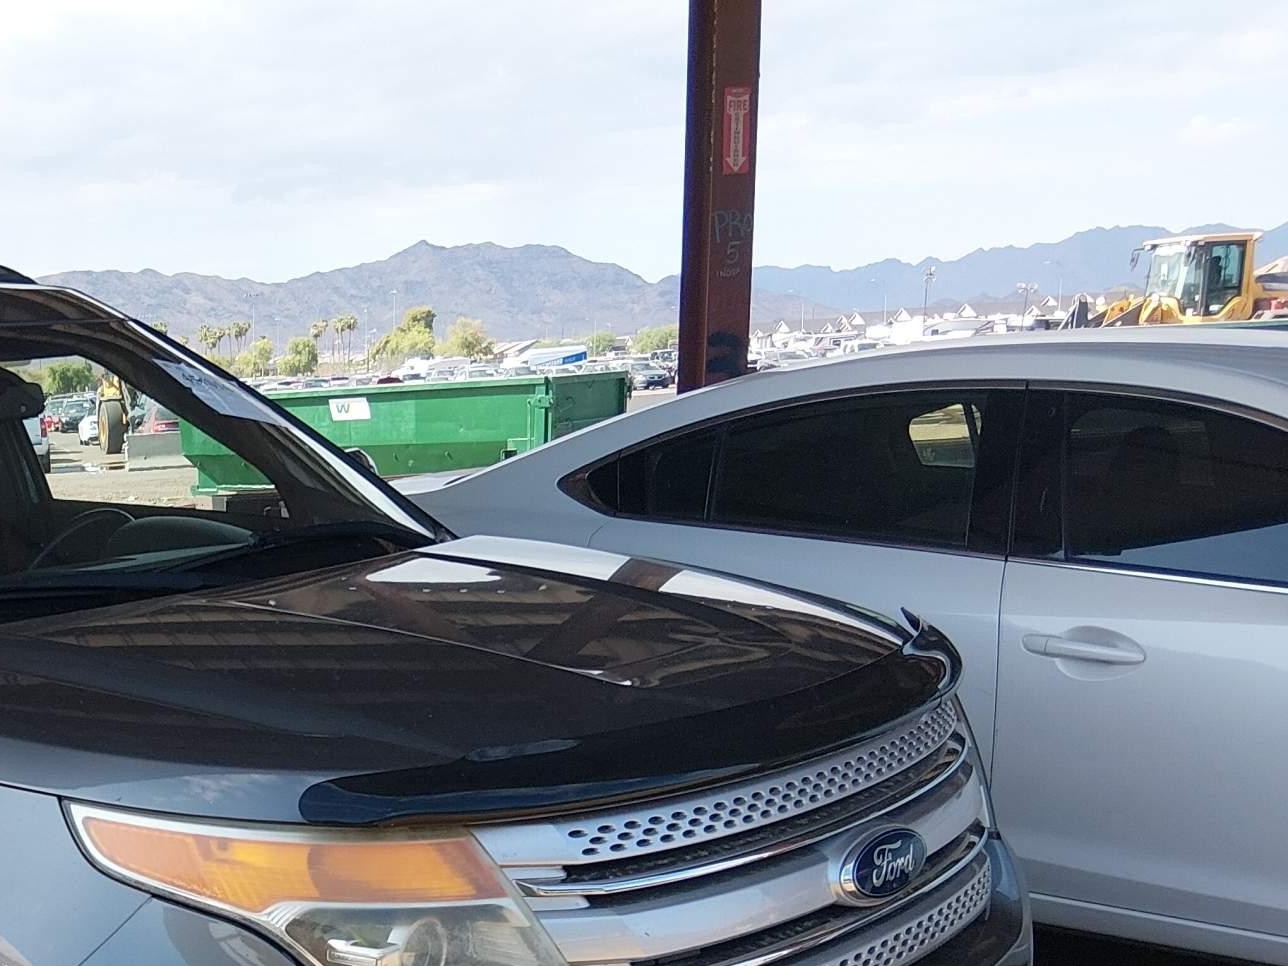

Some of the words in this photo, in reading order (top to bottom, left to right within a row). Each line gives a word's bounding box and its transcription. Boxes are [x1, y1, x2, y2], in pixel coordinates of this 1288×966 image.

[728, 99, 748, 112] FIRE
[727, 240, 742, 264] 5
[872, 839, 914, 887] Ford
